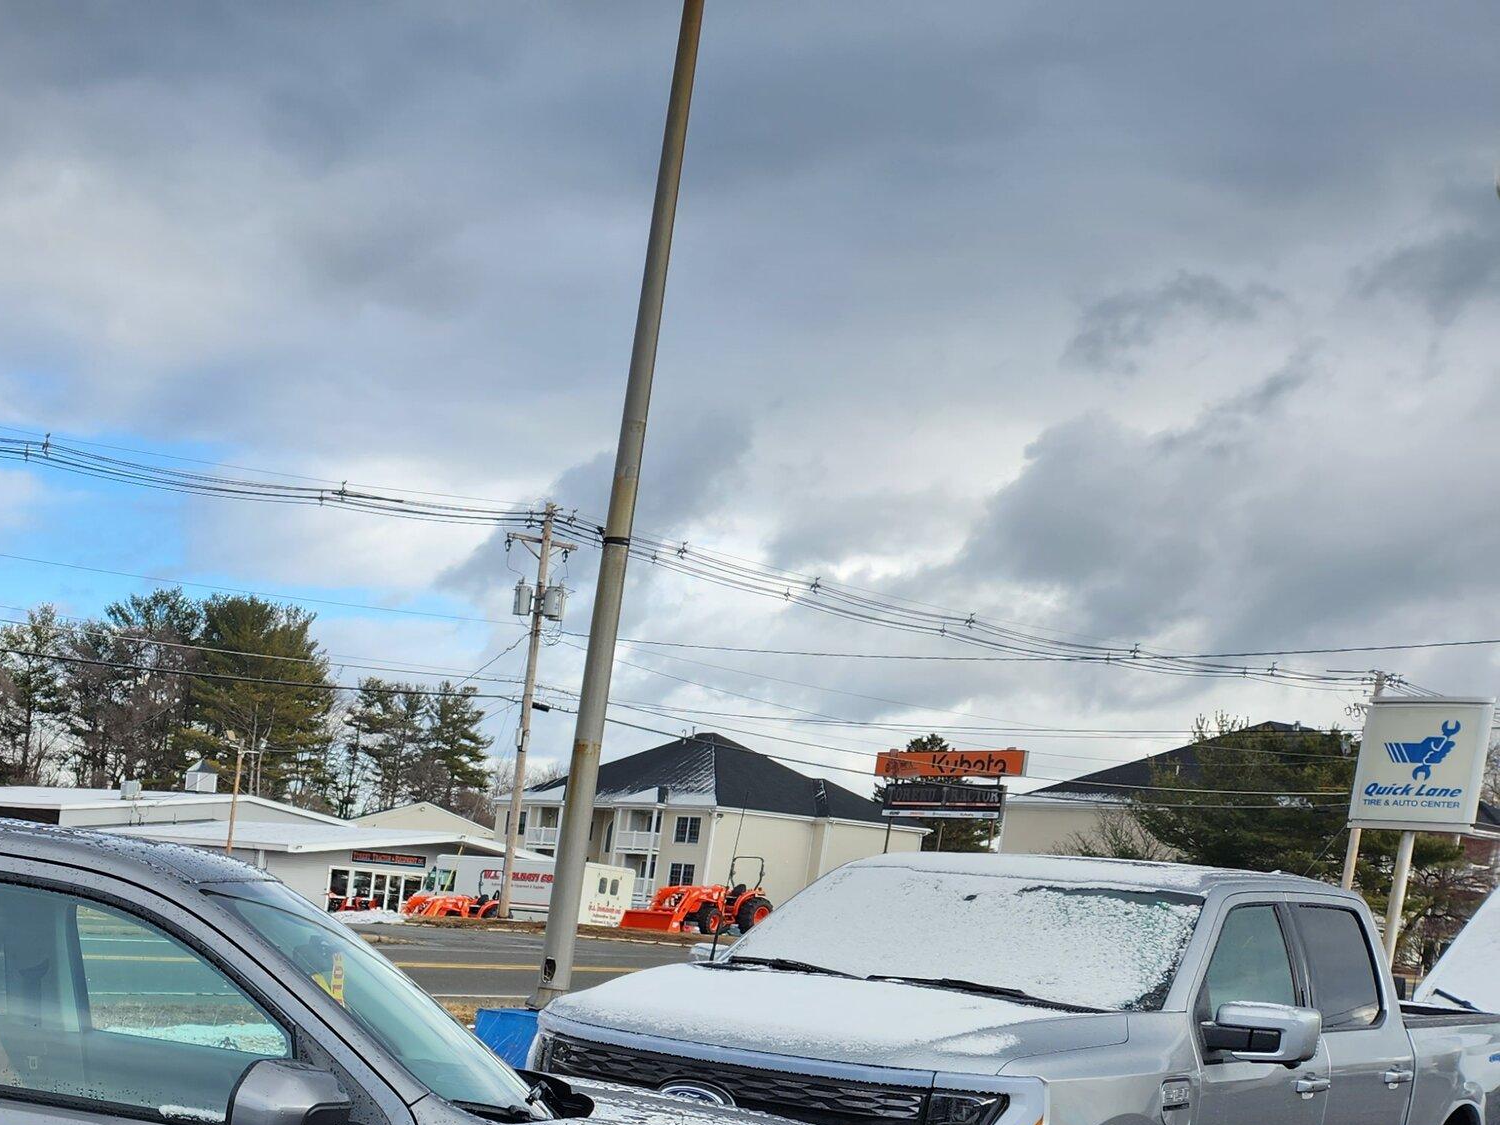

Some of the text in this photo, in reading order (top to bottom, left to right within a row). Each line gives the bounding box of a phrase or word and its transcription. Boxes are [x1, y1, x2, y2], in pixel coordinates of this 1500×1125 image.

[931, 754, 1007, 774] Kubota
[941, 786, 999, 805] TRACTOR
[1364, 782, 1462, 797] Quick Lane
[1421, 800, 1460, 808] CENTER
